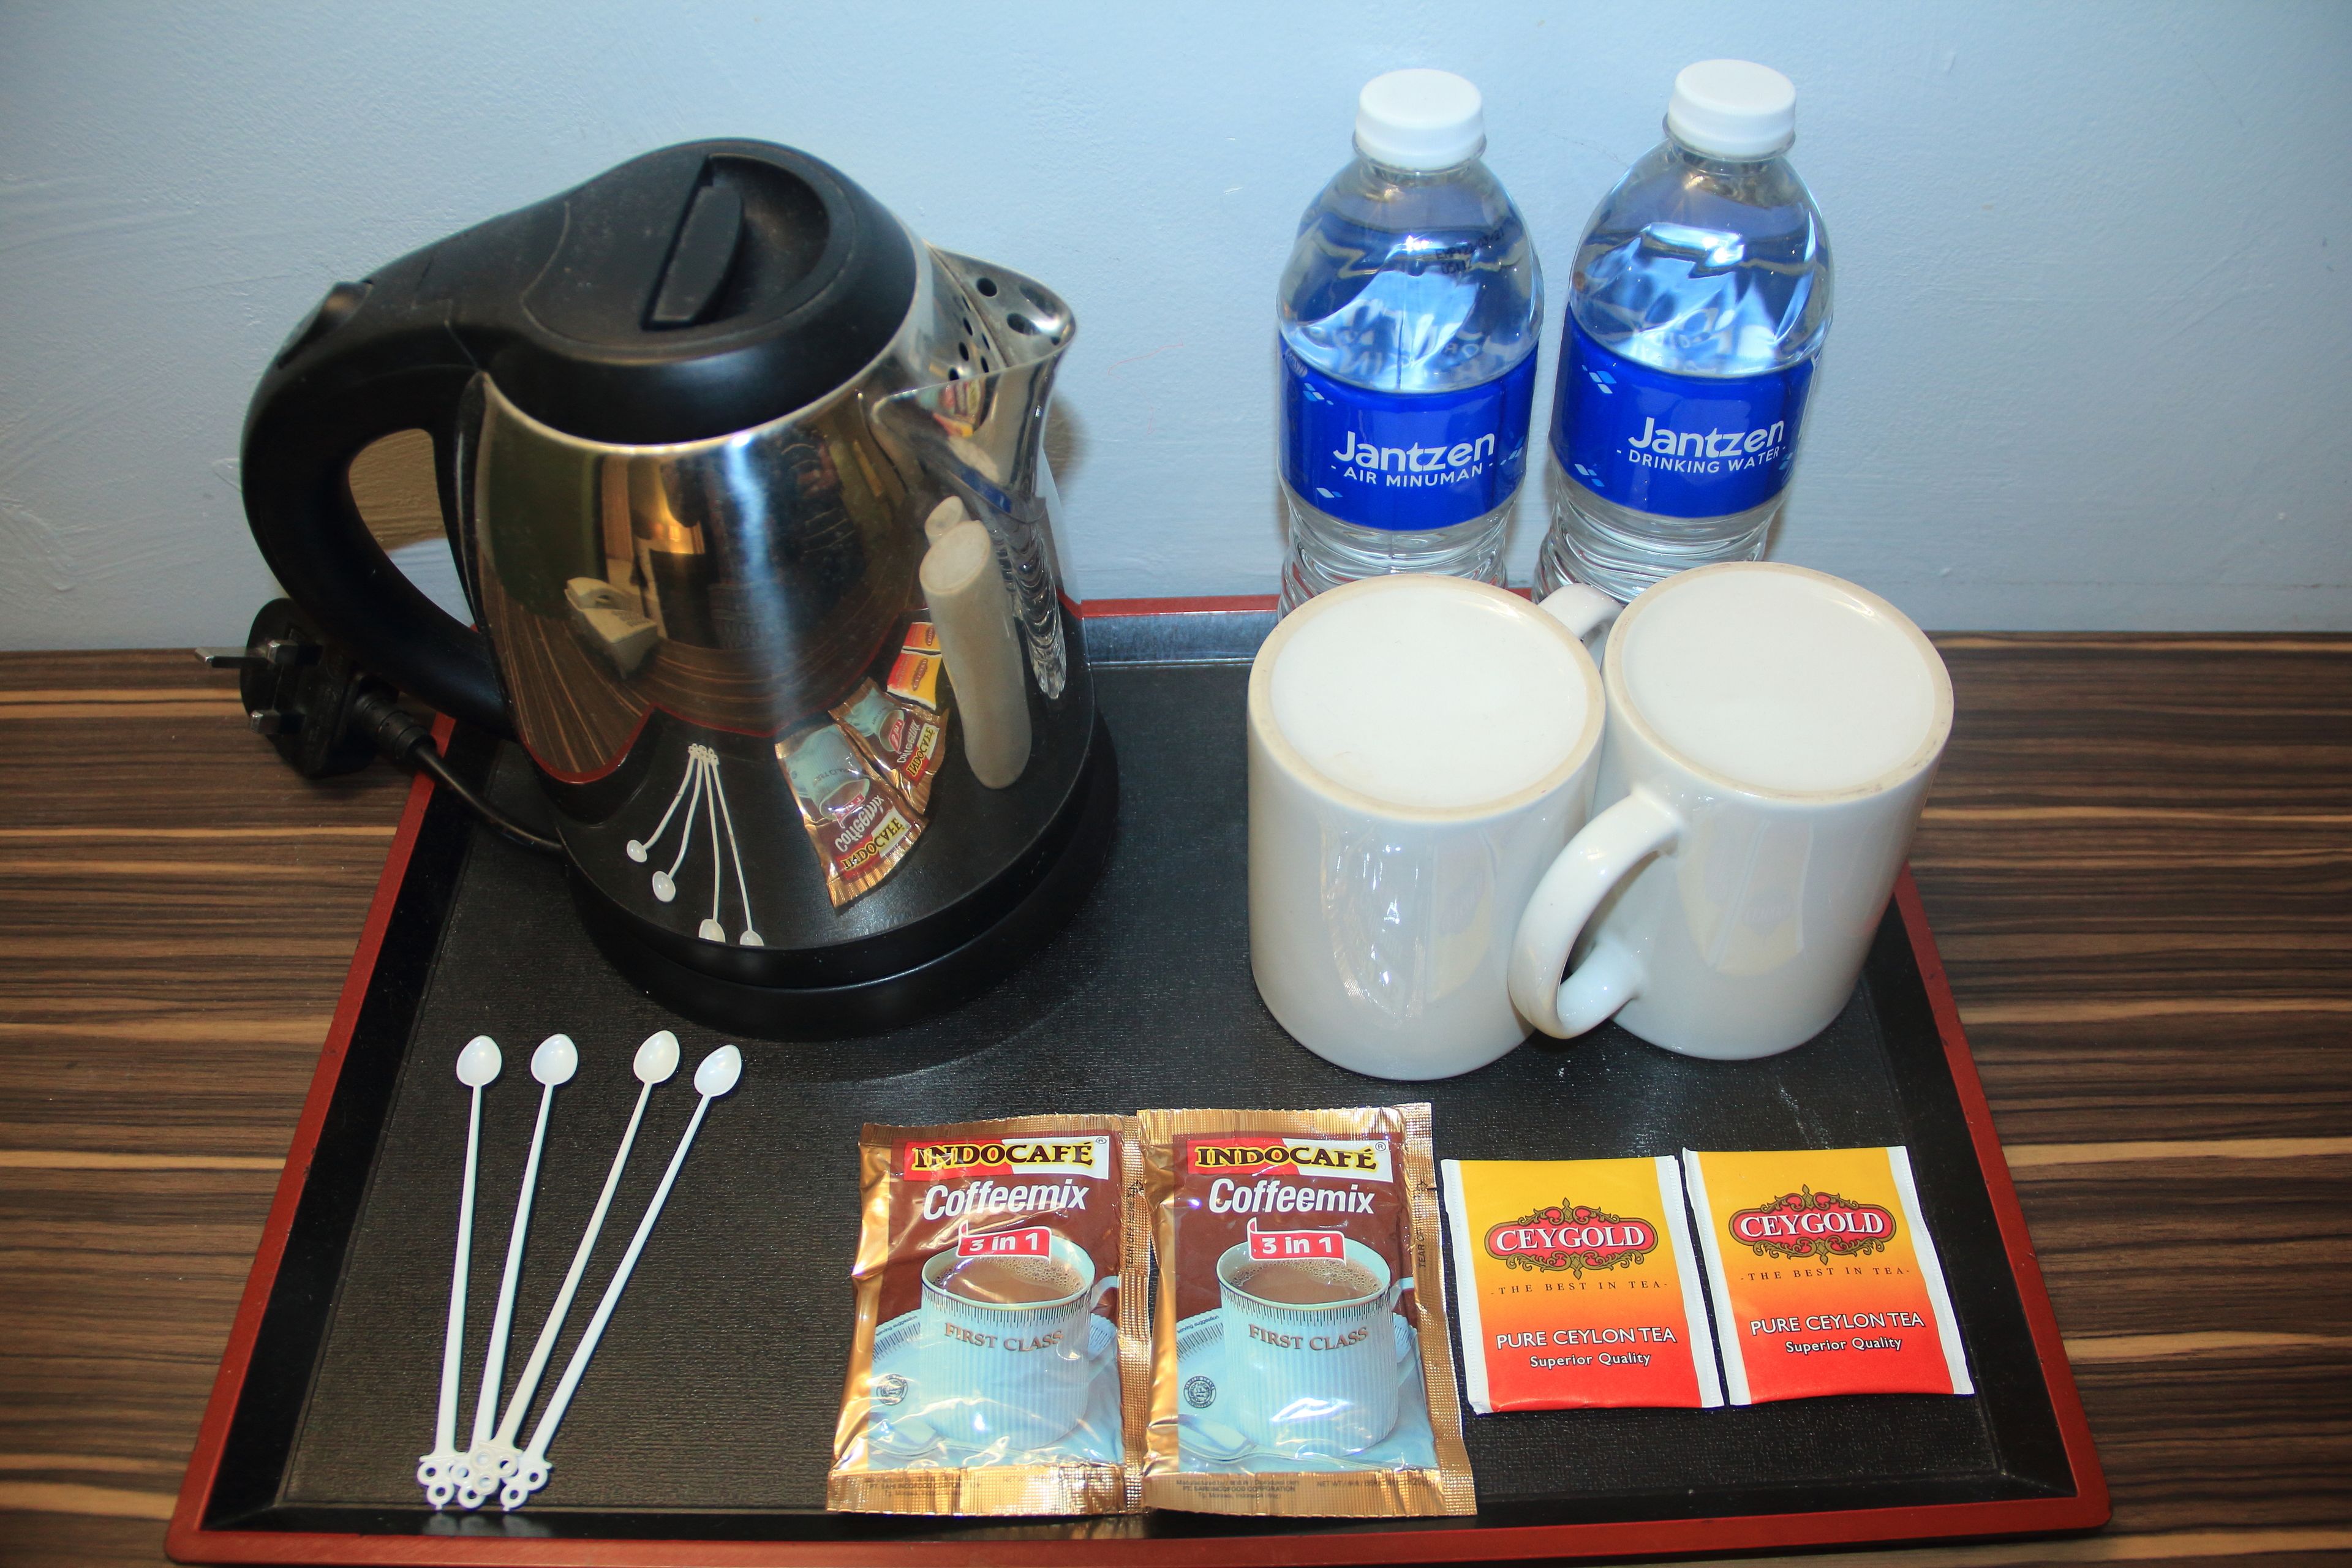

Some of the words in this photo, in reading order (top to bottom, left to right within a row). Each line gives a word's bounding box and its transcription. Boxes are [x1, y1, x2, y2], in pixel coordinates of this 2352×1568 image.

[1628, 417, 1785, 458] Jantzen
[1333, 431, 1495, 472] Jantzen
[1628, 449, 1720, 473] DRINKING
[1728, 450, 1780, 472] WATER
[1343, 466, 1377, 484] AIR
[1386, 466, 1483, 488] MINUMAN
[913, 1142, 1094, 1169] INDOCAFÉ
[1196, 1146, 1377, 1170] INDOCAFÉ
[923, 1178, 1090, 1221] Coffeemix
[1208, 1178, 1375, 1215] Coffeemix
[1740, 1212, 1884, 1237] CEYGOLD
[969, 1237, 983, 1251] 3
[992, 1235, 1017, 1251] in
[1025, 1232, 1038, 1250] 1
[1262, 1238, 1276, 1254] 3
[1286, 1237, 1310, 1254] in
[1319, 1237, 1332, 1253] 1
[1496, 1226, 1645, 1251] CEYGOLD
[1417, 1244, 1426, 1268] TEAR
[1793, 1267, 1834, 1278] BEST
[1845, 1267, 1863, 1275] IN
[1545, 1282, 1586, 1291] BEST
[1599, 1281, 1617, 1290] IN
[1194, 1314, 1219, 1329] suggestion
[1750, 1317, 1801, 1336] PURE
[1806, 1313, 1887, 1331] CEYLON
[1887, 1312, 1926, 1328] TEA
[944, 1322, 998, 1349] FIRST
[1003, 1330, 1065, 1352] CLASS
[1248, 1323, 1303, 1350] FIRST
[1309, 1326, 1369, 1351] CLASS
[1496, 1331, 1548, 1349] PURE
[1553, 1327, 1635, 1346] CEYLON
[1637, 1327, 1678, 1343] TEA
[1785, 1340, 1847, 1355] Superior
[1851, 1336, 1902, 1351] Quality
[1529, 1354, 1593, 1370] Superior
[1598, 1352, 1651, 1366] Quality
